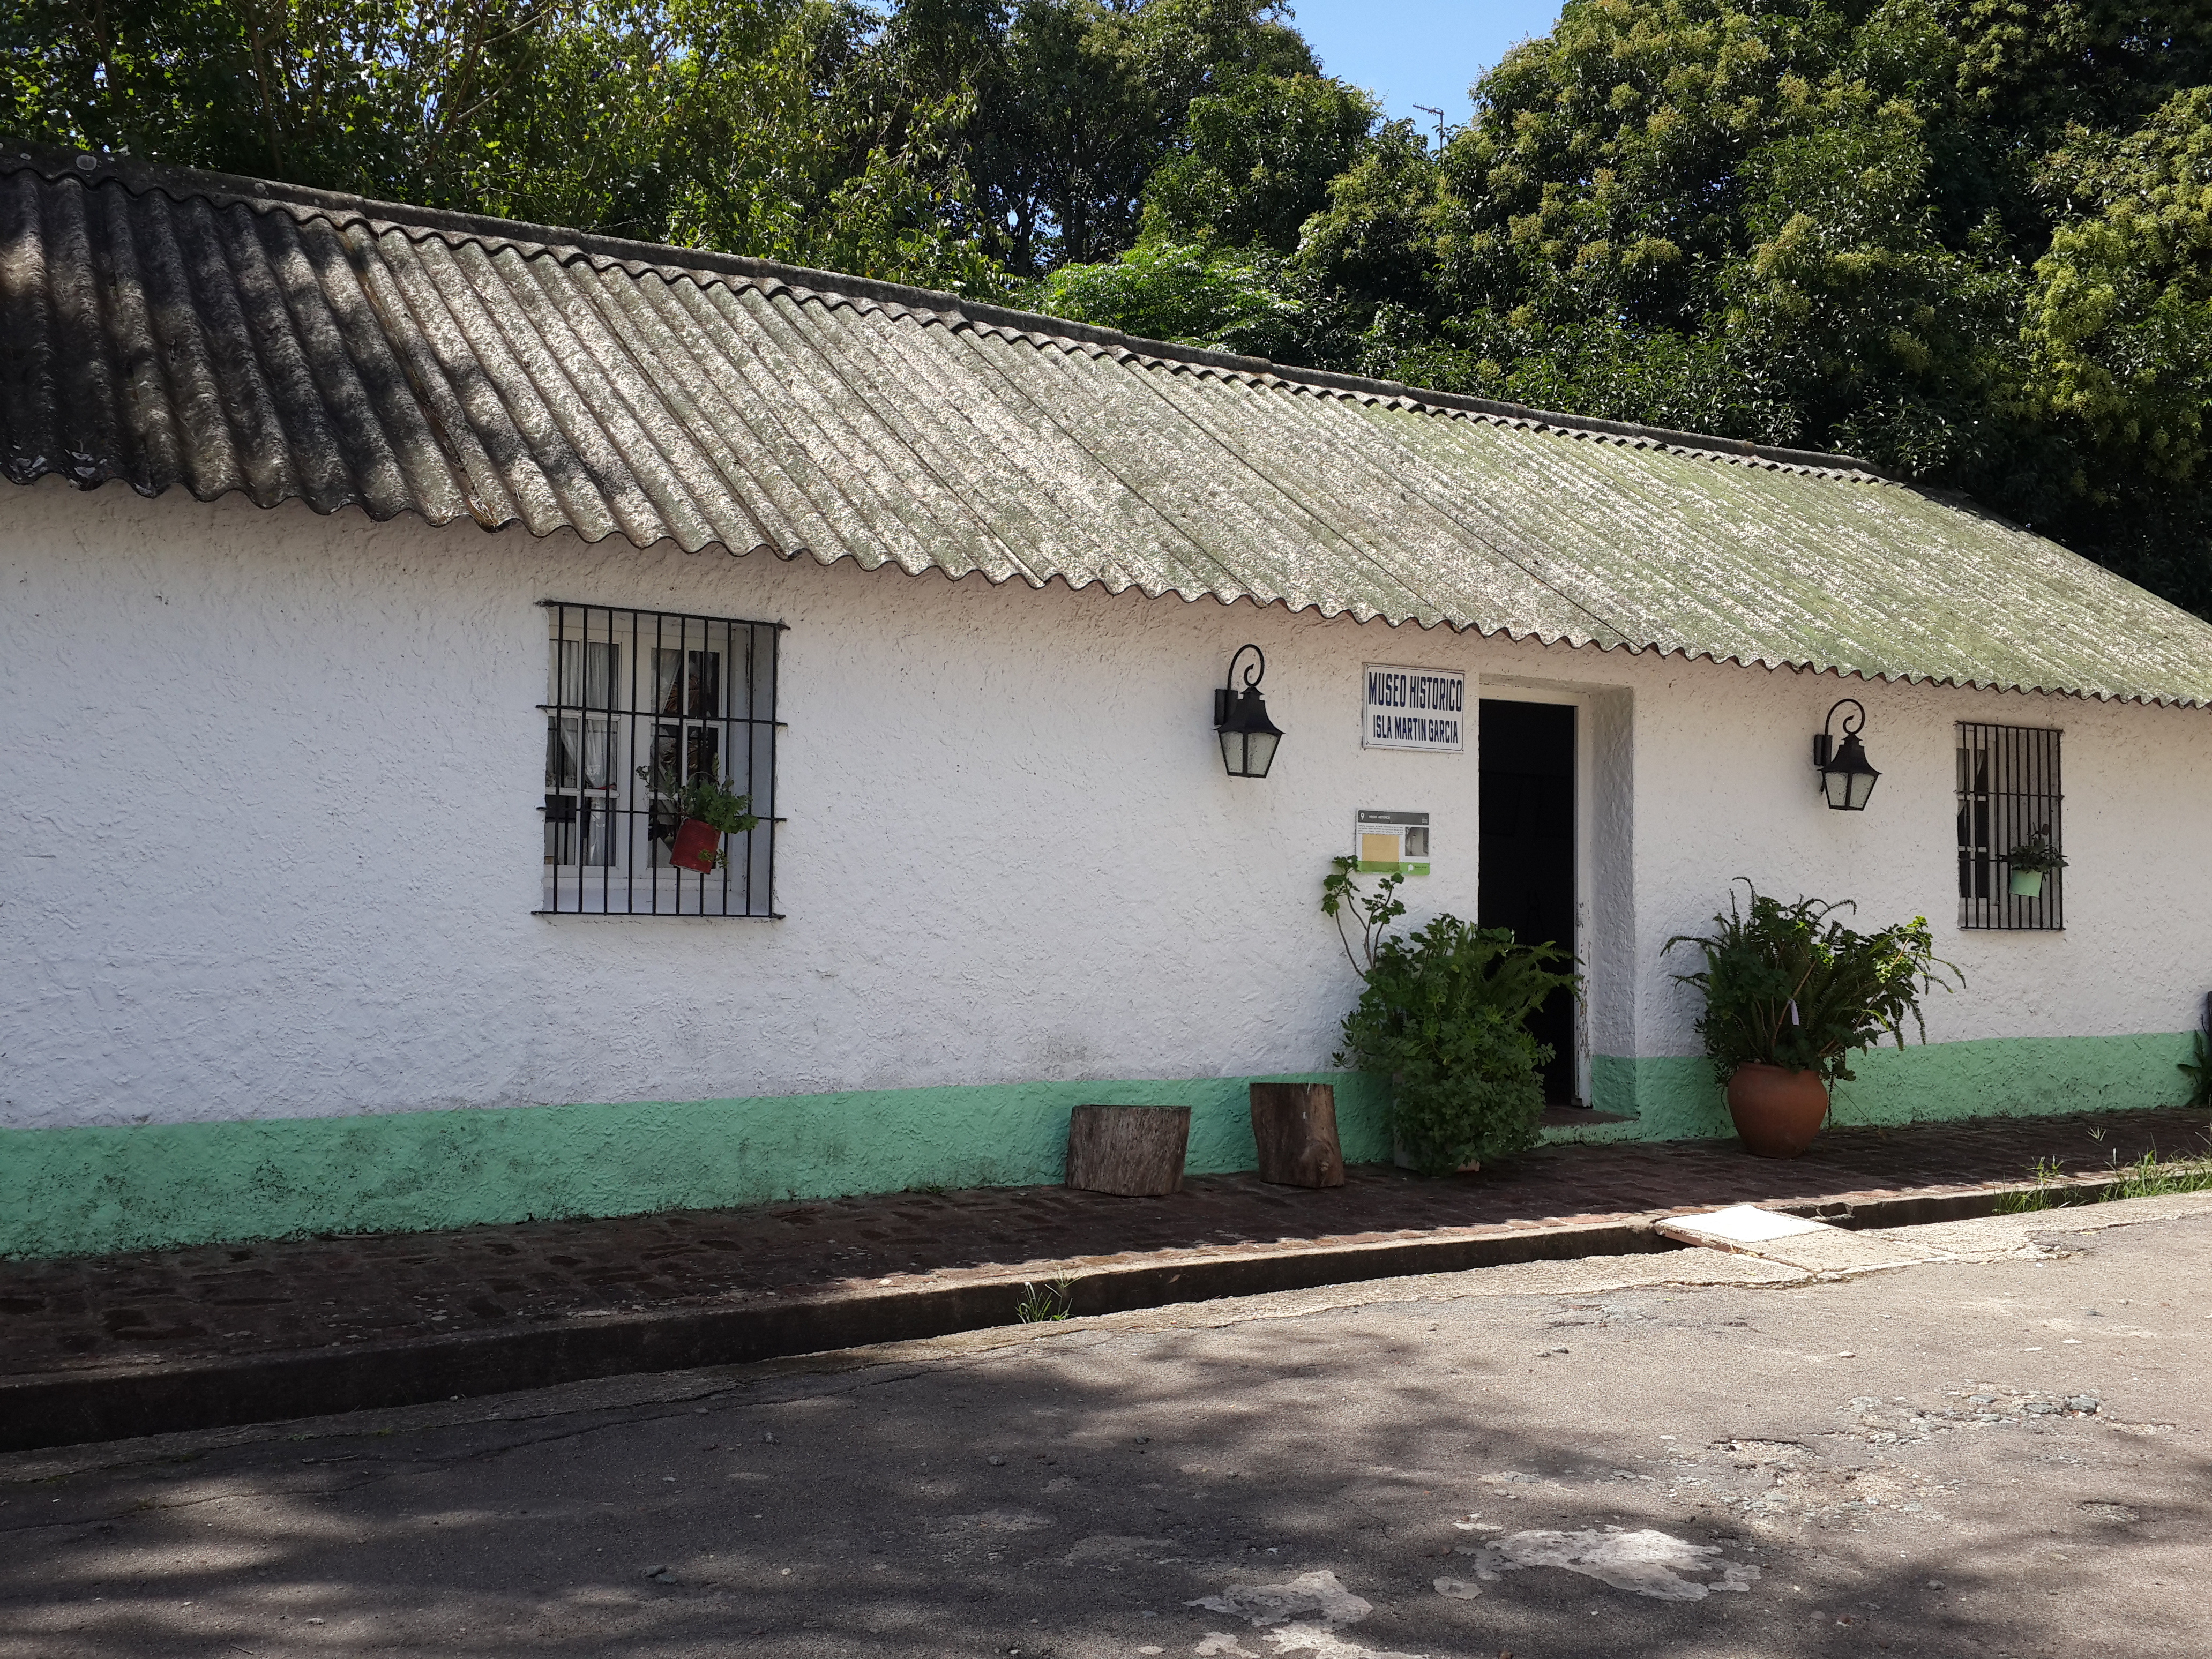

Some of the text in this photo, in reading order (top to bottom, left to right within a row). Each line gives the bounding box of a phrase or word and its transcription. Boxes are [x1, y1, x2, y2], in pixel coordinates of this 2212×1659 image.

[1369, 672, 1462, 712] MUSEO HISTORICO
[1373, 714, 1458, 744] ISLA MARTIN GARCIA
